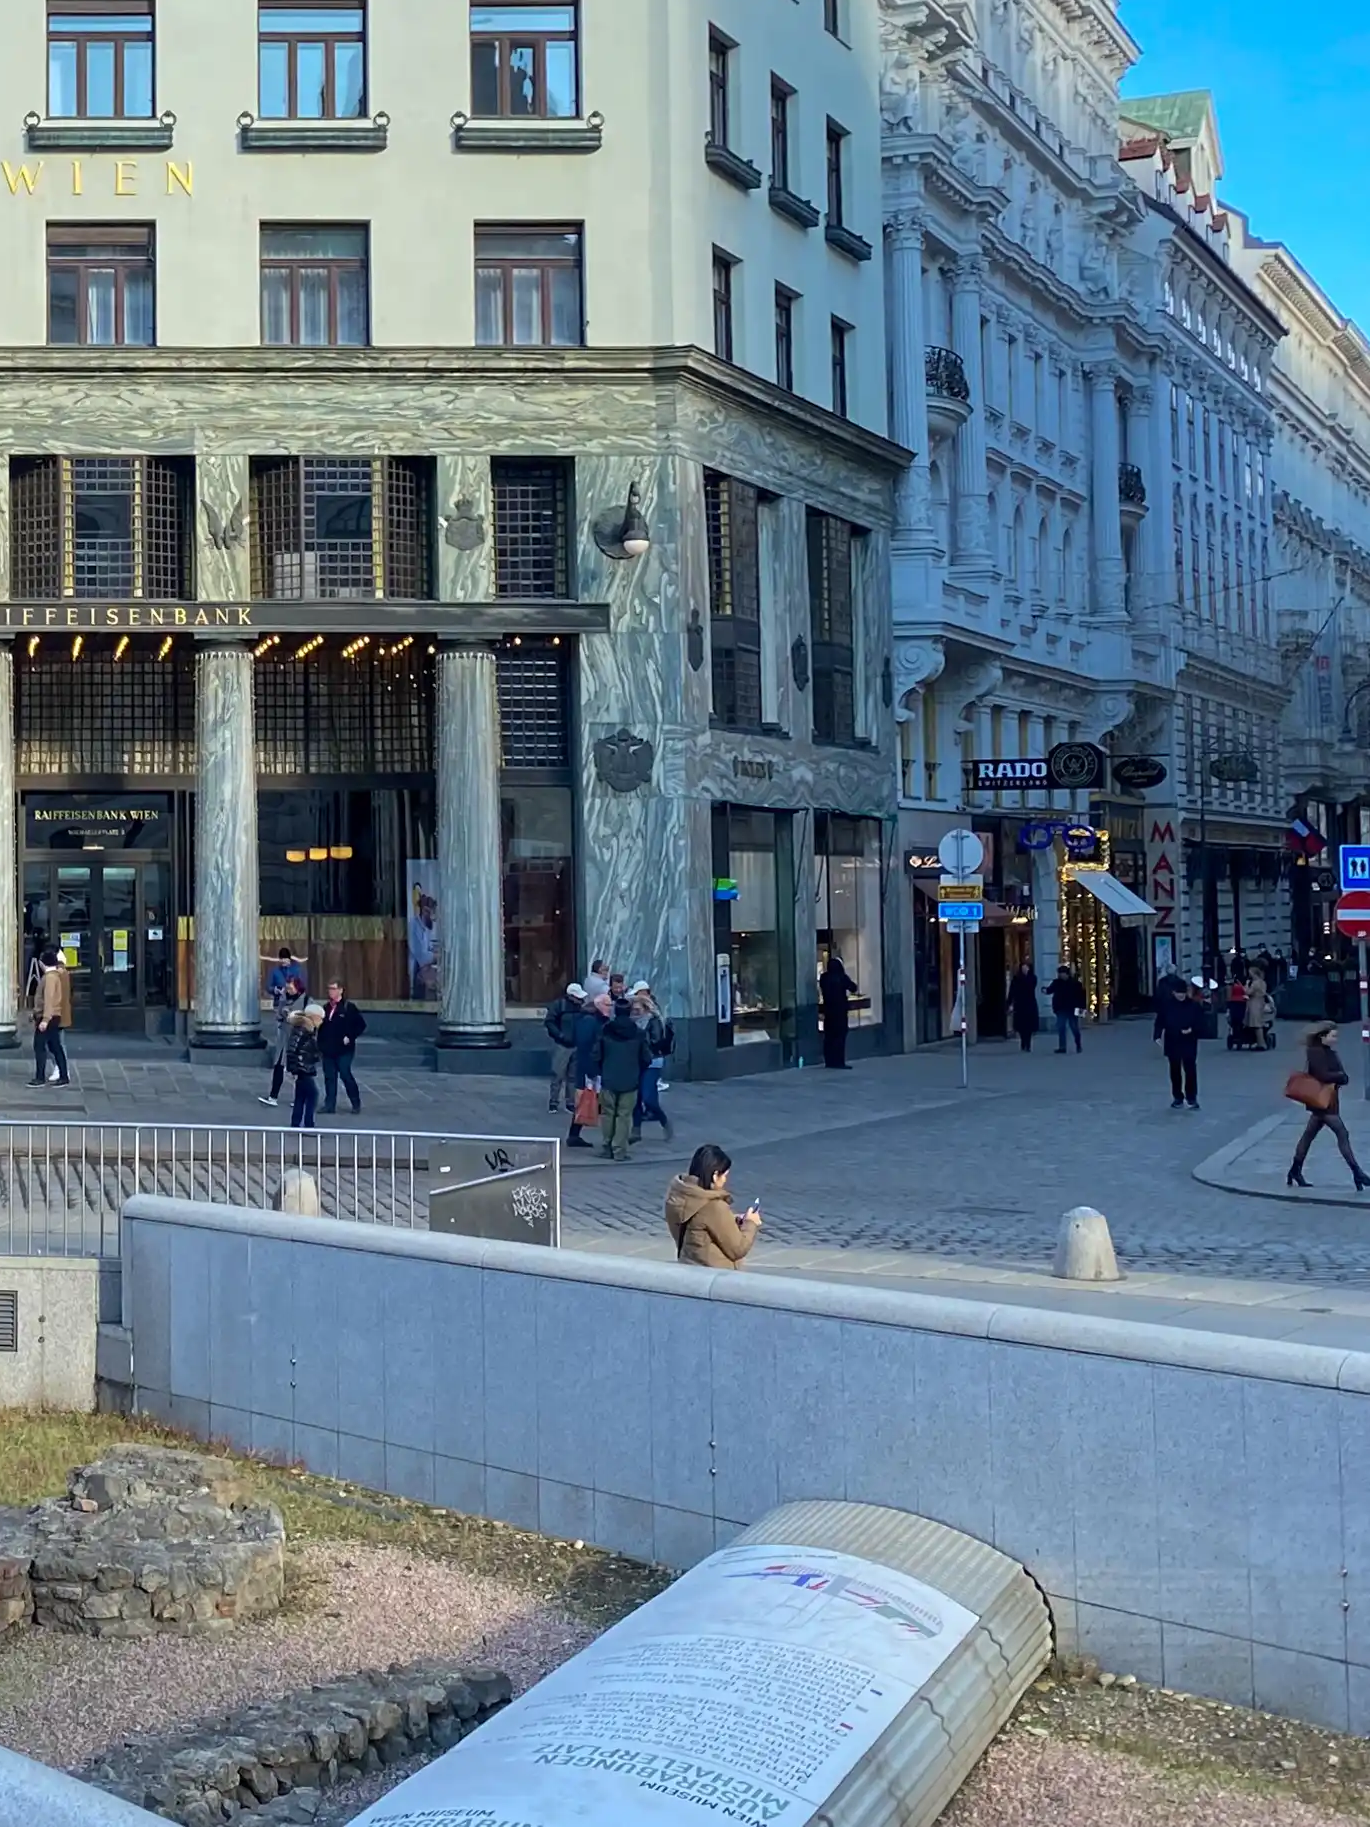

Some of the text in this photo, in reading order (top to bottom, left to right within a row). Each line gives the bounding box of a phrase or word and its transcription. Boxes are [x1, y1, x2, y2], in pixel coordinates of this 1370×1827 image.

[0, 160, 194, 197] WIEN
[978, 762, 1048, 778] RADO
[34, 810, 159, 820] RAIFFEISENBANK WIEN
[1150, 820, 1176, 929] MANZ
[532, 1745, 791, 1812] MICHAELERPLATZ
[534, 1755, 781, 1820] AUSGRABUNGEN
[416, 1809, 496, 1818] MUSEUM
[639, 1781, 768, 1827] WIEN MUSEUM
